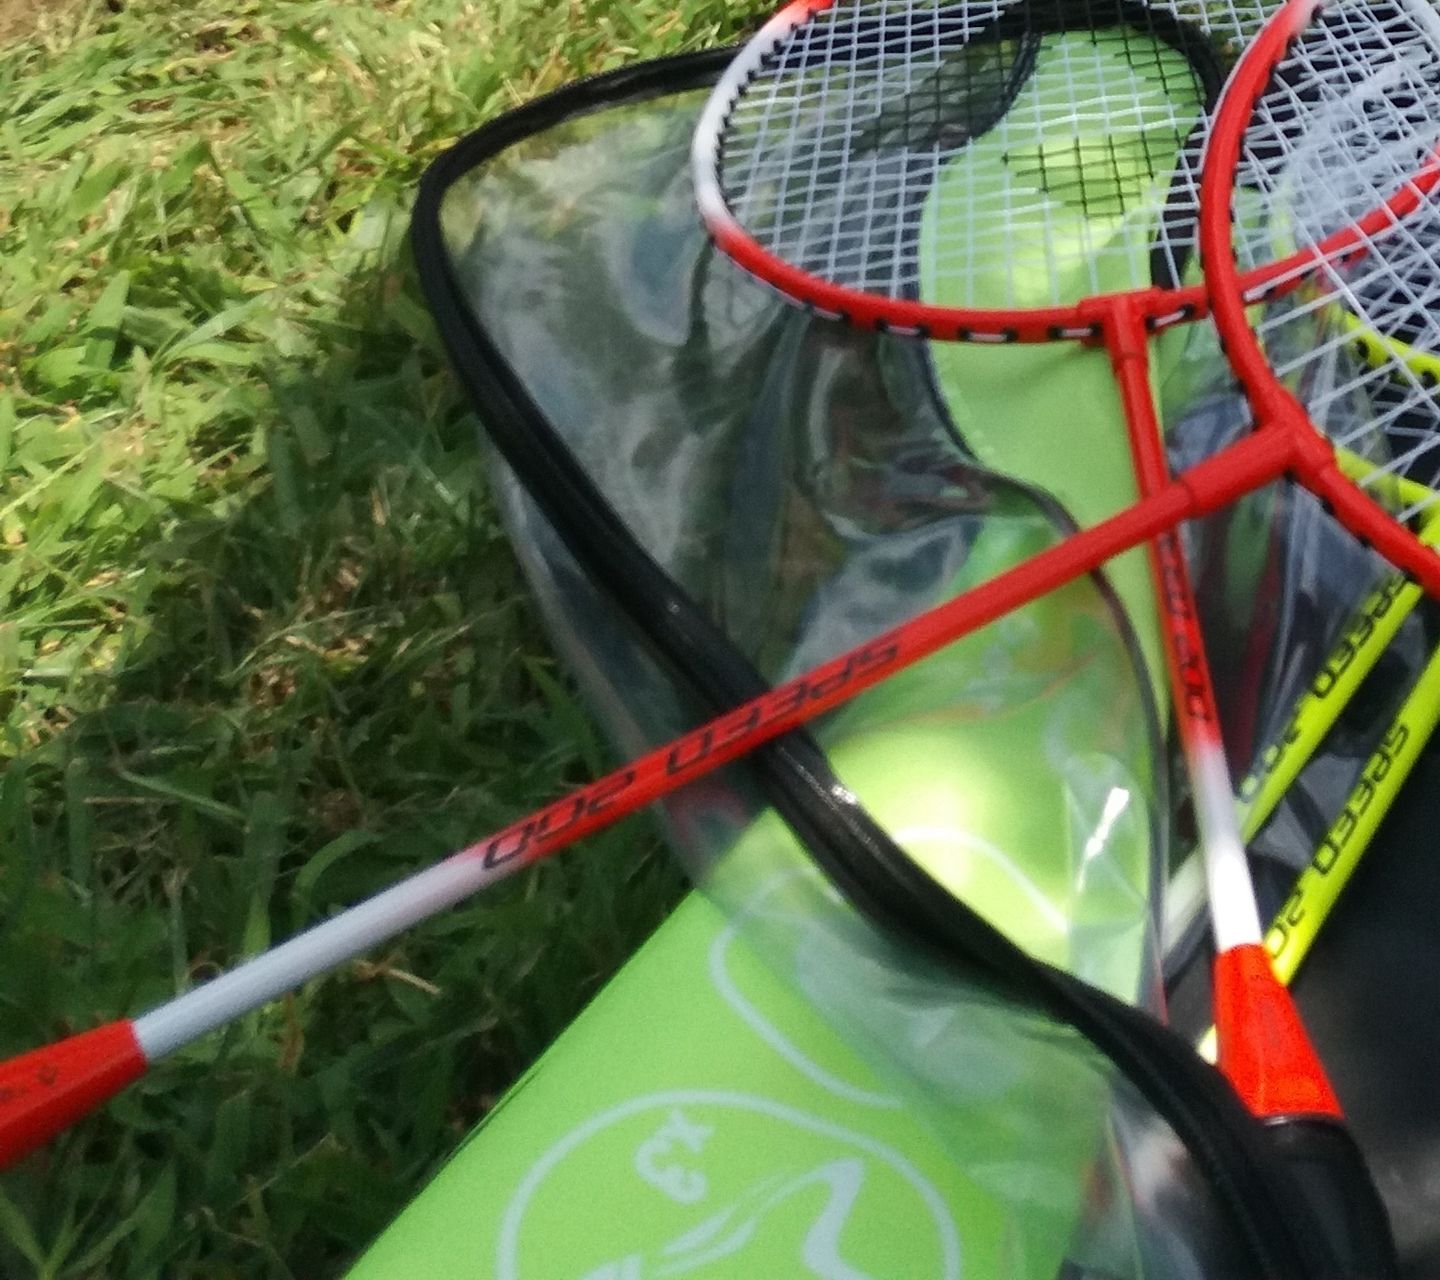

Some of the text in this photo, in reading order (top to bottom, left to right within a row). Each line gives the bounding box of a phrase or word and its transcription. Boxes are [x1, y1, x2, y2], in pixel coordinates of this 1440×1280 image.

[482, 644, 899, 870] SPEED 200
[1262, 725, 1409, 959] SPEED 20
